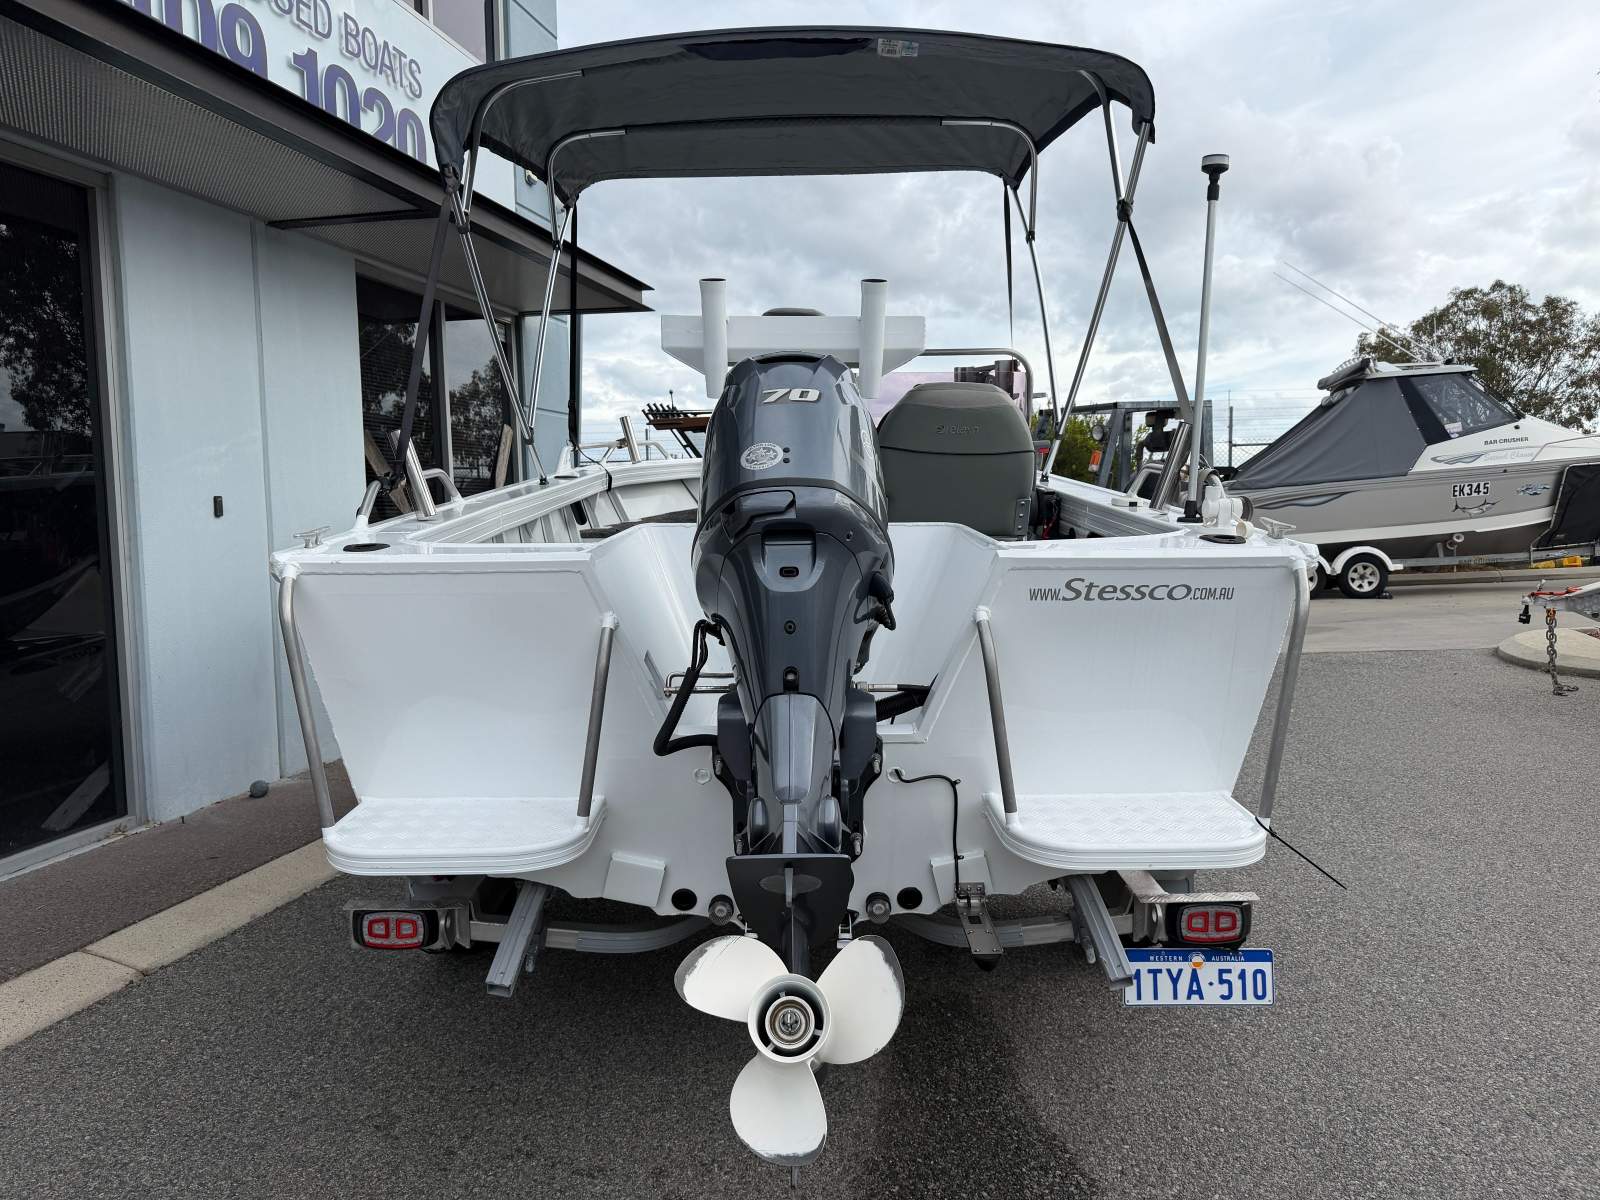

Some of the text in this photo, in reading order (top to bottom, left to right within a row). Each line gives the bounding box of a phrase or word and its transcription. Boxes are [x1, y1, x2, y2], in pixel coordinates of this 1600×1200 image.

[343, 12, 422, 99] BOATS
[292, 47, 426, 164] 1020
[762, 388, 821, 404] 70
[1499, 436, 1529, 444] CRUSHER
[1452, 482, 1490, 497] EK345
